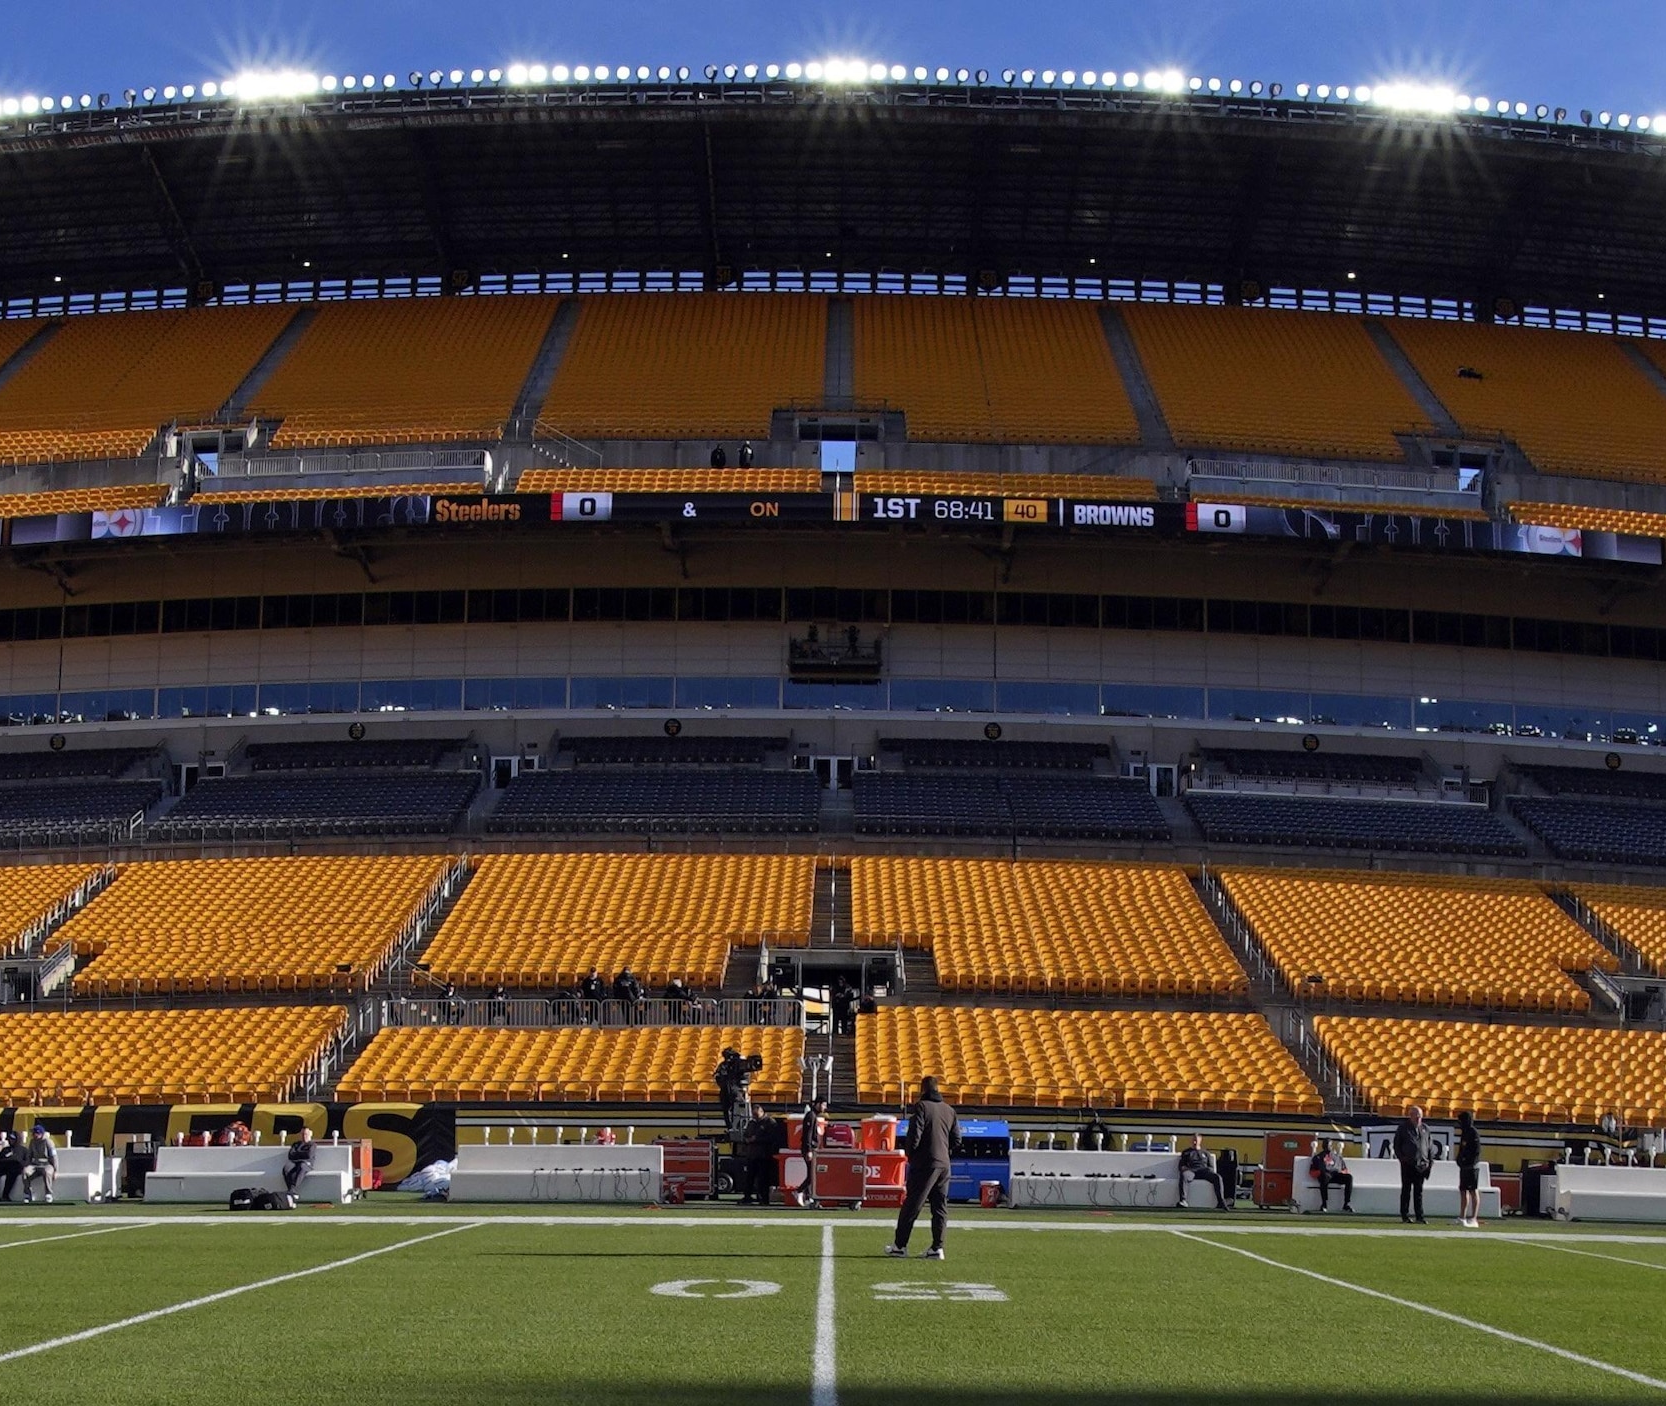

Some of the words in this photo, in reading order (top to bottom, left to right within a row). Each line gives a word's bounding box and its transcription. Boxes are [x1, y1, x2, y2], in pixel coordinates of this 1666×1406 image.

[435, 498, 521, 521] Steelers
[579, 497, 597, 517] 0
[682, 502, 697, 518] &
[750, 501, 779, 517] ON
[873, 497, 921, 518] 1ST
[934, 500, 995, 521] 68:41
[1014, 502, 1037, 518] 40
[1073, 504, 1154, 527] BROWNS
[1213, 509, 1230, 528] 0
